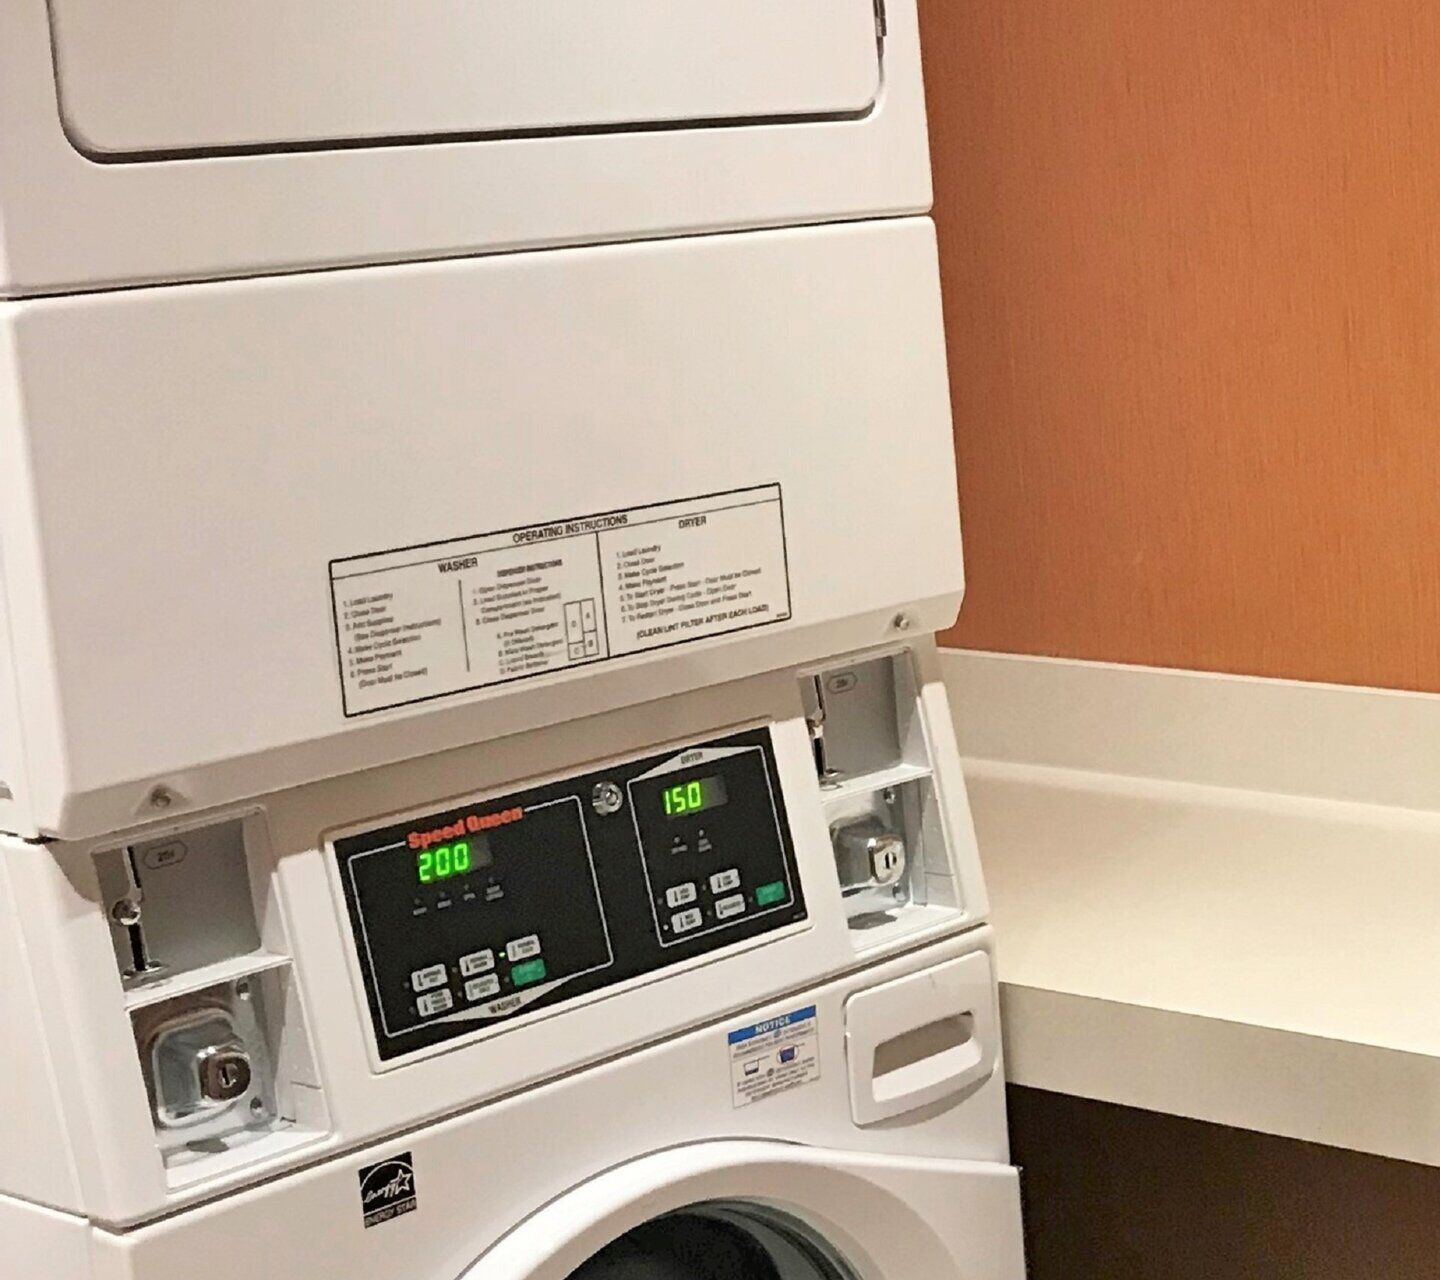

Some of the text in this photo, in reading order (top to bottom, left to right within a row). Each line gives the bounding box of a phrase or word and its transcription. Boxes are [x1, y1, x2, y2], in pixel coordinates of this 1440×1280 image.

[513, 514, 628, 543] OPERATING INSTRUCTIONS
[438, 557, 478, 573] WASHER
[665, 781, 701, 814] 150
[407, 806, 523, 849] Speed Queen
[419, 843, 468, 881] 200
[755, 1015, 791, 1034] NOTICE
